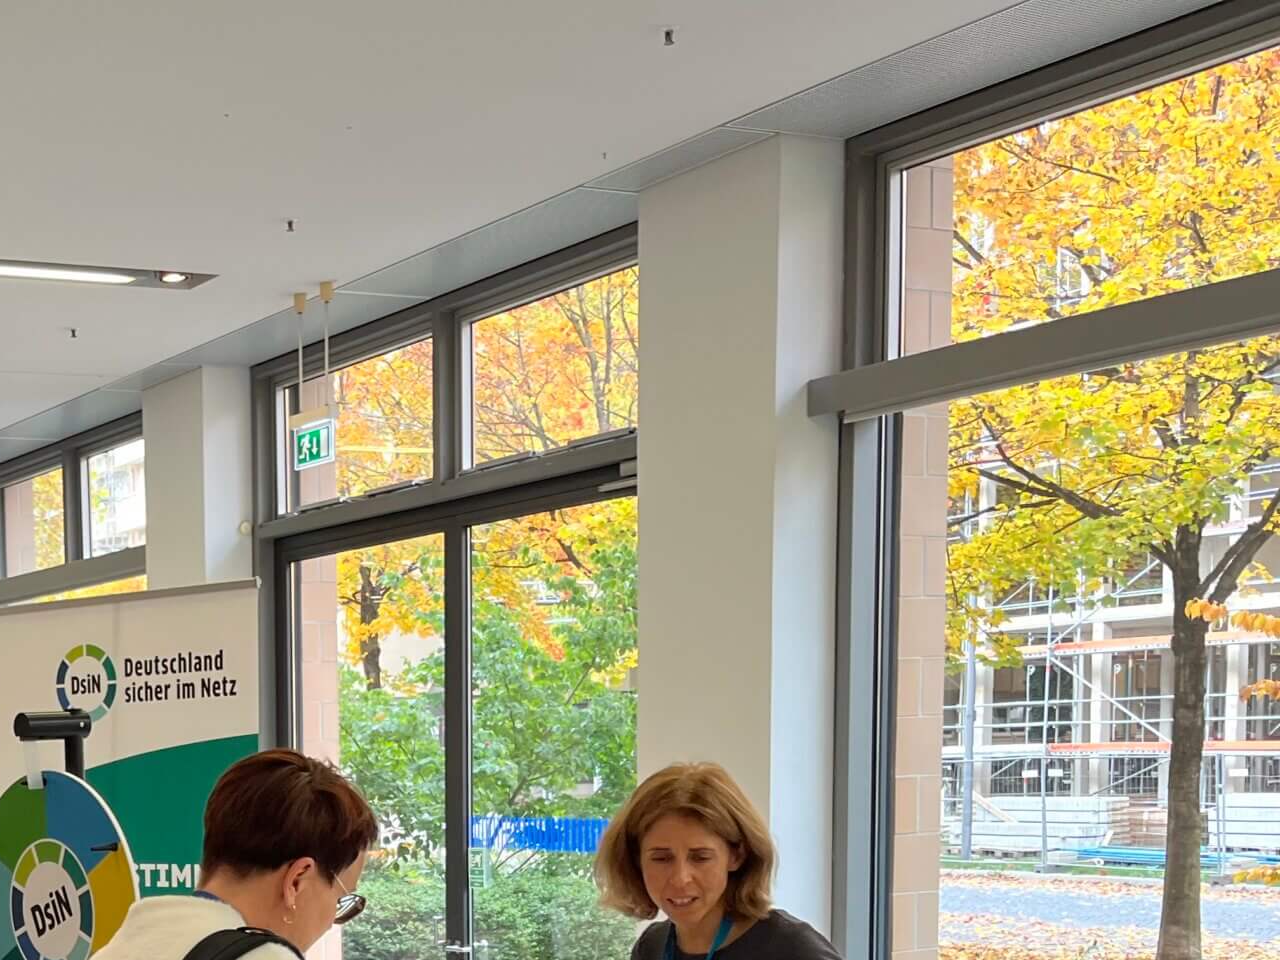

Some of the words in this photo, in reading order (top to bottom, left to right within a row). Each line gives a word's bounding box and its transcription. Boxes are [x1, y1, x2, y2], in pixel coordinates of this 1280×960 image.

[124, 649, 224, 677] Deutschland
[71, 674, 102, 695] DsiN
[124, 681, 171, 703] sicher
[176, 679, 196, 700] im
[201, 676, 237, 698] Netz
[30, 885, 73, 938] DsiN
